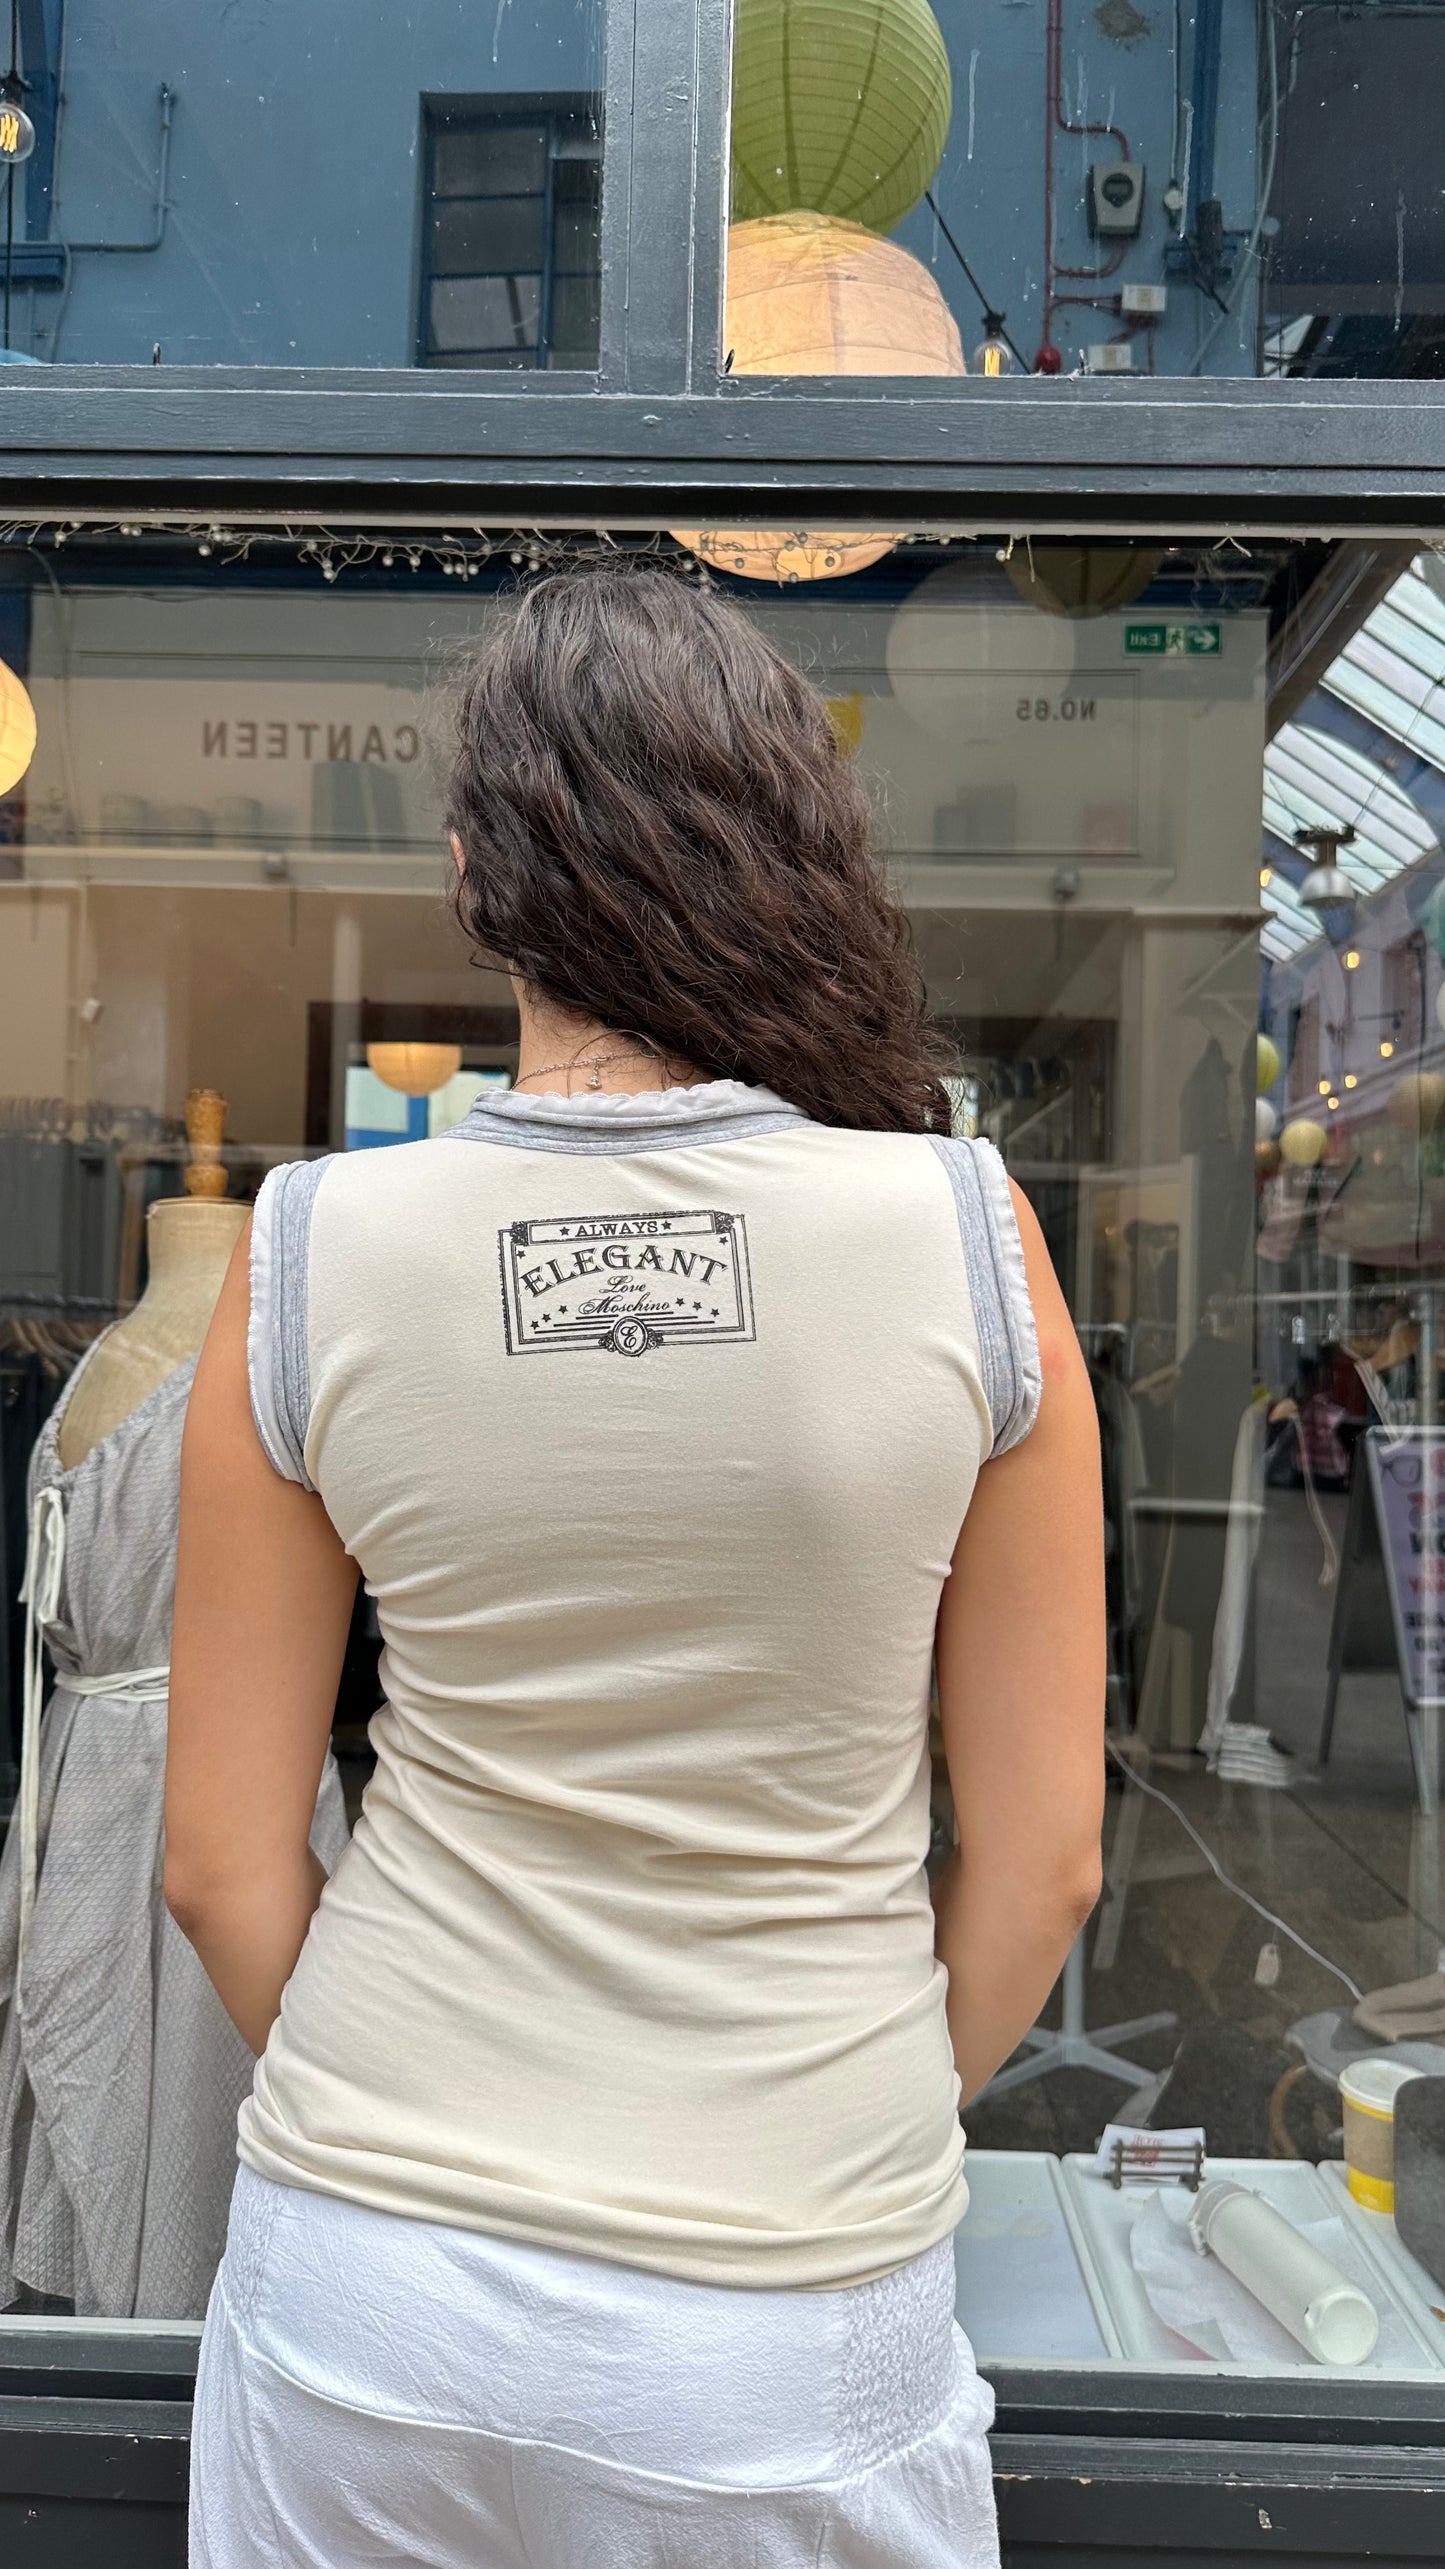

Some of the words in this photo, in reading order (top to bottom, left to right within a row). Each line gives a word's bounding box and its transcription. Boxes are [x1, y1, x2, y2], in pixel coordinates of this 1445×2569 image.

[575, 1221, 658, 1237] ALWAYS
[519, 1244, 728, 1298] ELEGANT
[599, 1275, 646, 1294] Love
[578, 1292, 670, 1315] Moschino
[620, 1325, 639, 1349] E
